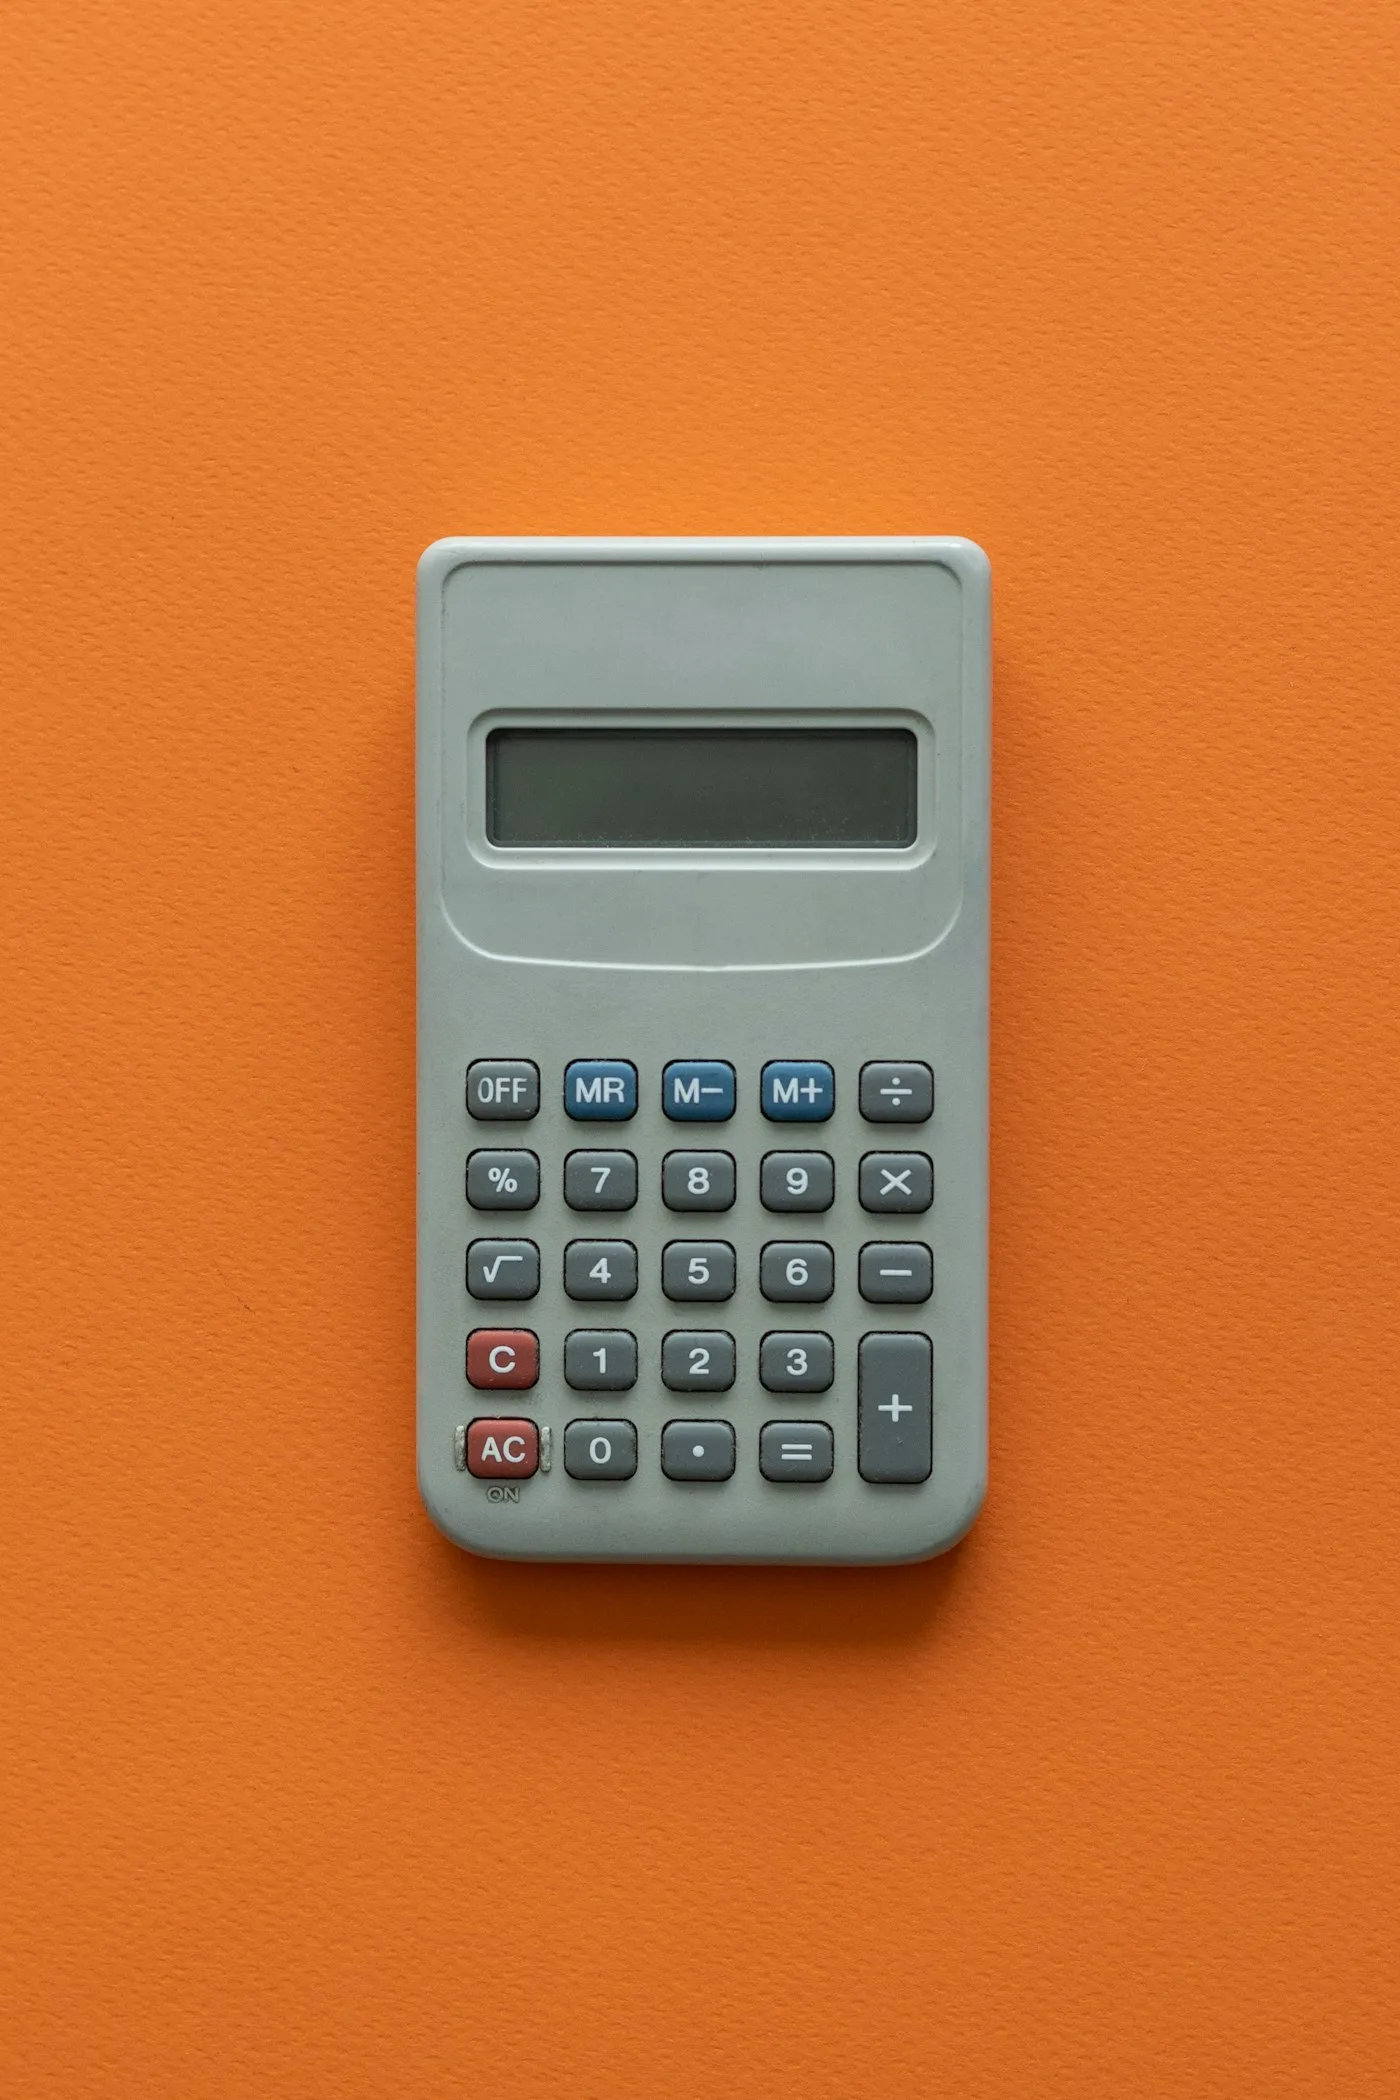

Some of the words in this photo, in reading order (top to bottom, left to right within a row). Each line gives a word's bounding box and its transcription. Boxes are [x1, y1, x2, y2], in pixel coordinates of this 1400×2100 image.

[477, 1077, 527, 1103] OFF
[576, 1077, 625, 1103] MR
[773, 1077, 823, 1104] M+
[488, 1167, 518, 1193] %
[590, 1167, 611, 1194] 7
[687, 1167, 710, 1195] 8
[786, 1167, 808, 1195] 9
[589, 1257, 612, 1284] 4
[688, 1257, 710, 1284] 5
[786, 1258, 809, 1286] 6
[488, 1345, 516, 1373] C
[592, 1347, 607, 1374] 1
[689, 1347, 710, 1375] 2
[786, 1348, 808, 1376] 3
[877, 1393, 913, 1423] +
[481, 1435, 526, 1463] AC
[589, 1436, 612, 1464] 0
[781, 1443, 813, 1461] =
[487, 1486, 520, 1503] ON
